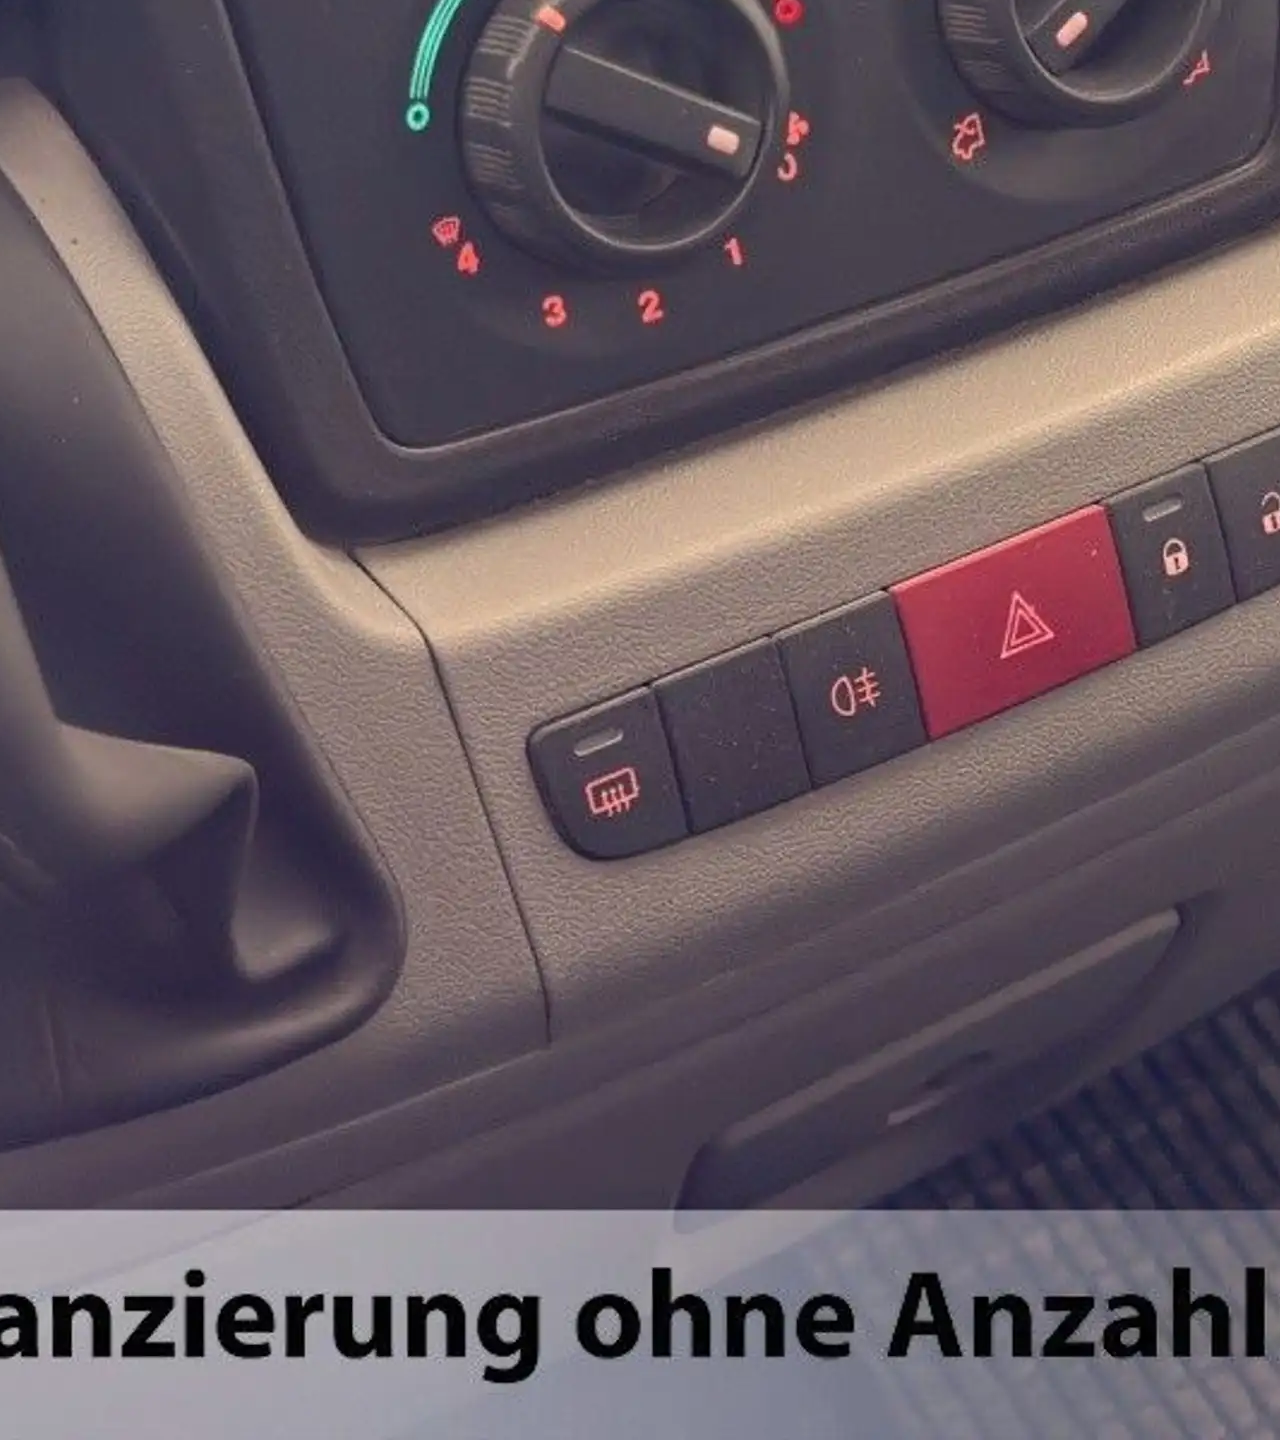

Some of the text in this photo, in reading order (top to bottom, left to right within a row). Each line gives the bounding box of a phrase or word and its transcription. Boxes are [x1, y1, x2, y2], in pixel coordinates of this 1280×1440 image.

[456, 242, 480, 274] 4
[723, 237, 743, 266] 1
[542, 295, 567, 328] 3
[638, 290, 664, 323] 2
